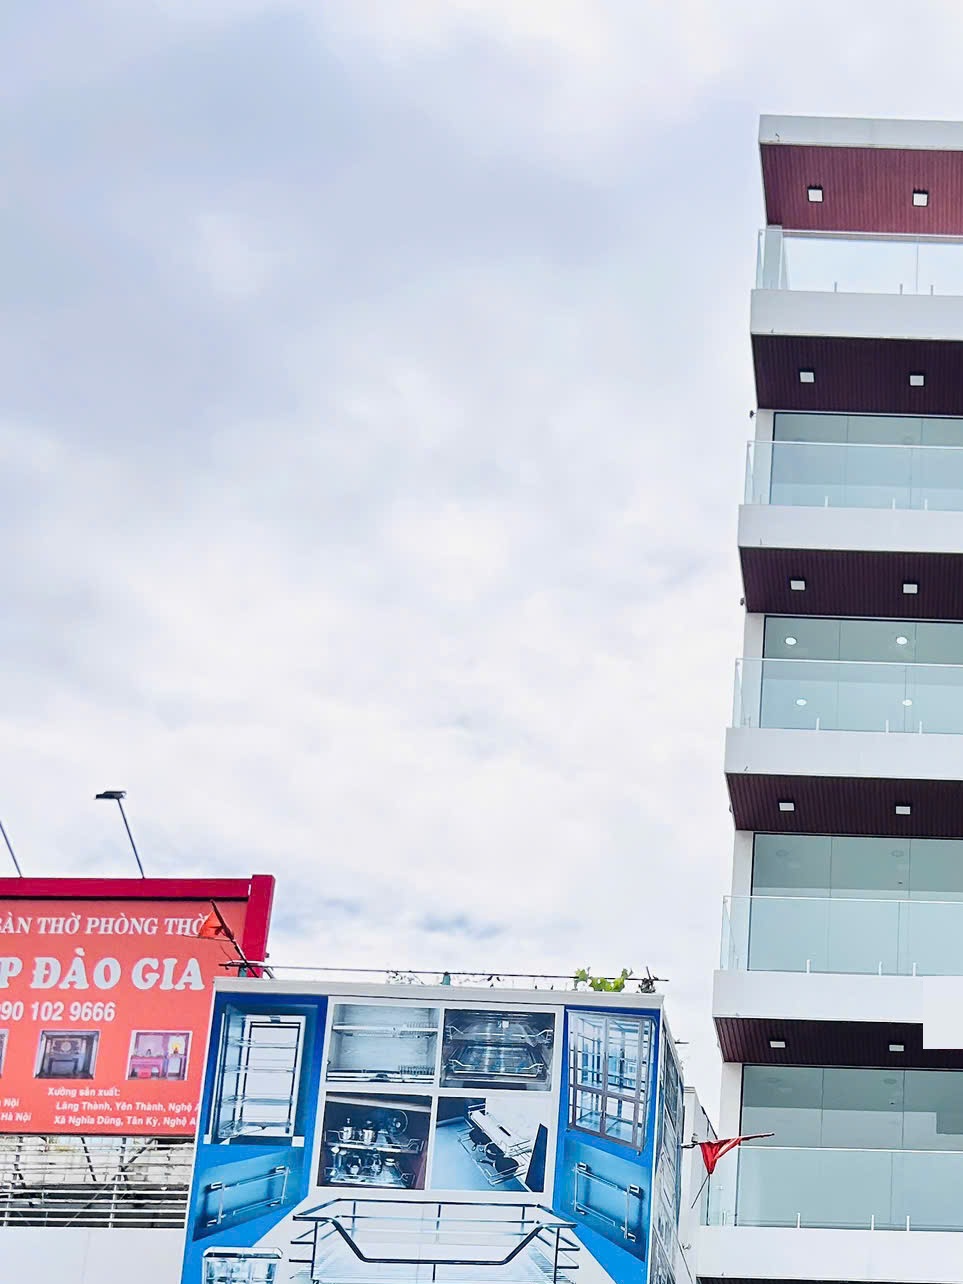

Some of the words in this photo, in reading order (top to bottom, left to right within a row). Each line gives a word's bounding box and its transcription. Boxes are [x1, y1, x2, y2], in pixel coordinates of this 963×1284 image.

[0, 912, 32, 934] ÀN
[37, 912, 81, 935] THỜ
[85, 912, 158, 935] PHÒNG
[30, 947, 121, 990] ĐÀO
[131, 957, 205, 990] GIA
[31, 1001, 65, 1020] 102
[69, 1001, 116, 1021] 9666
